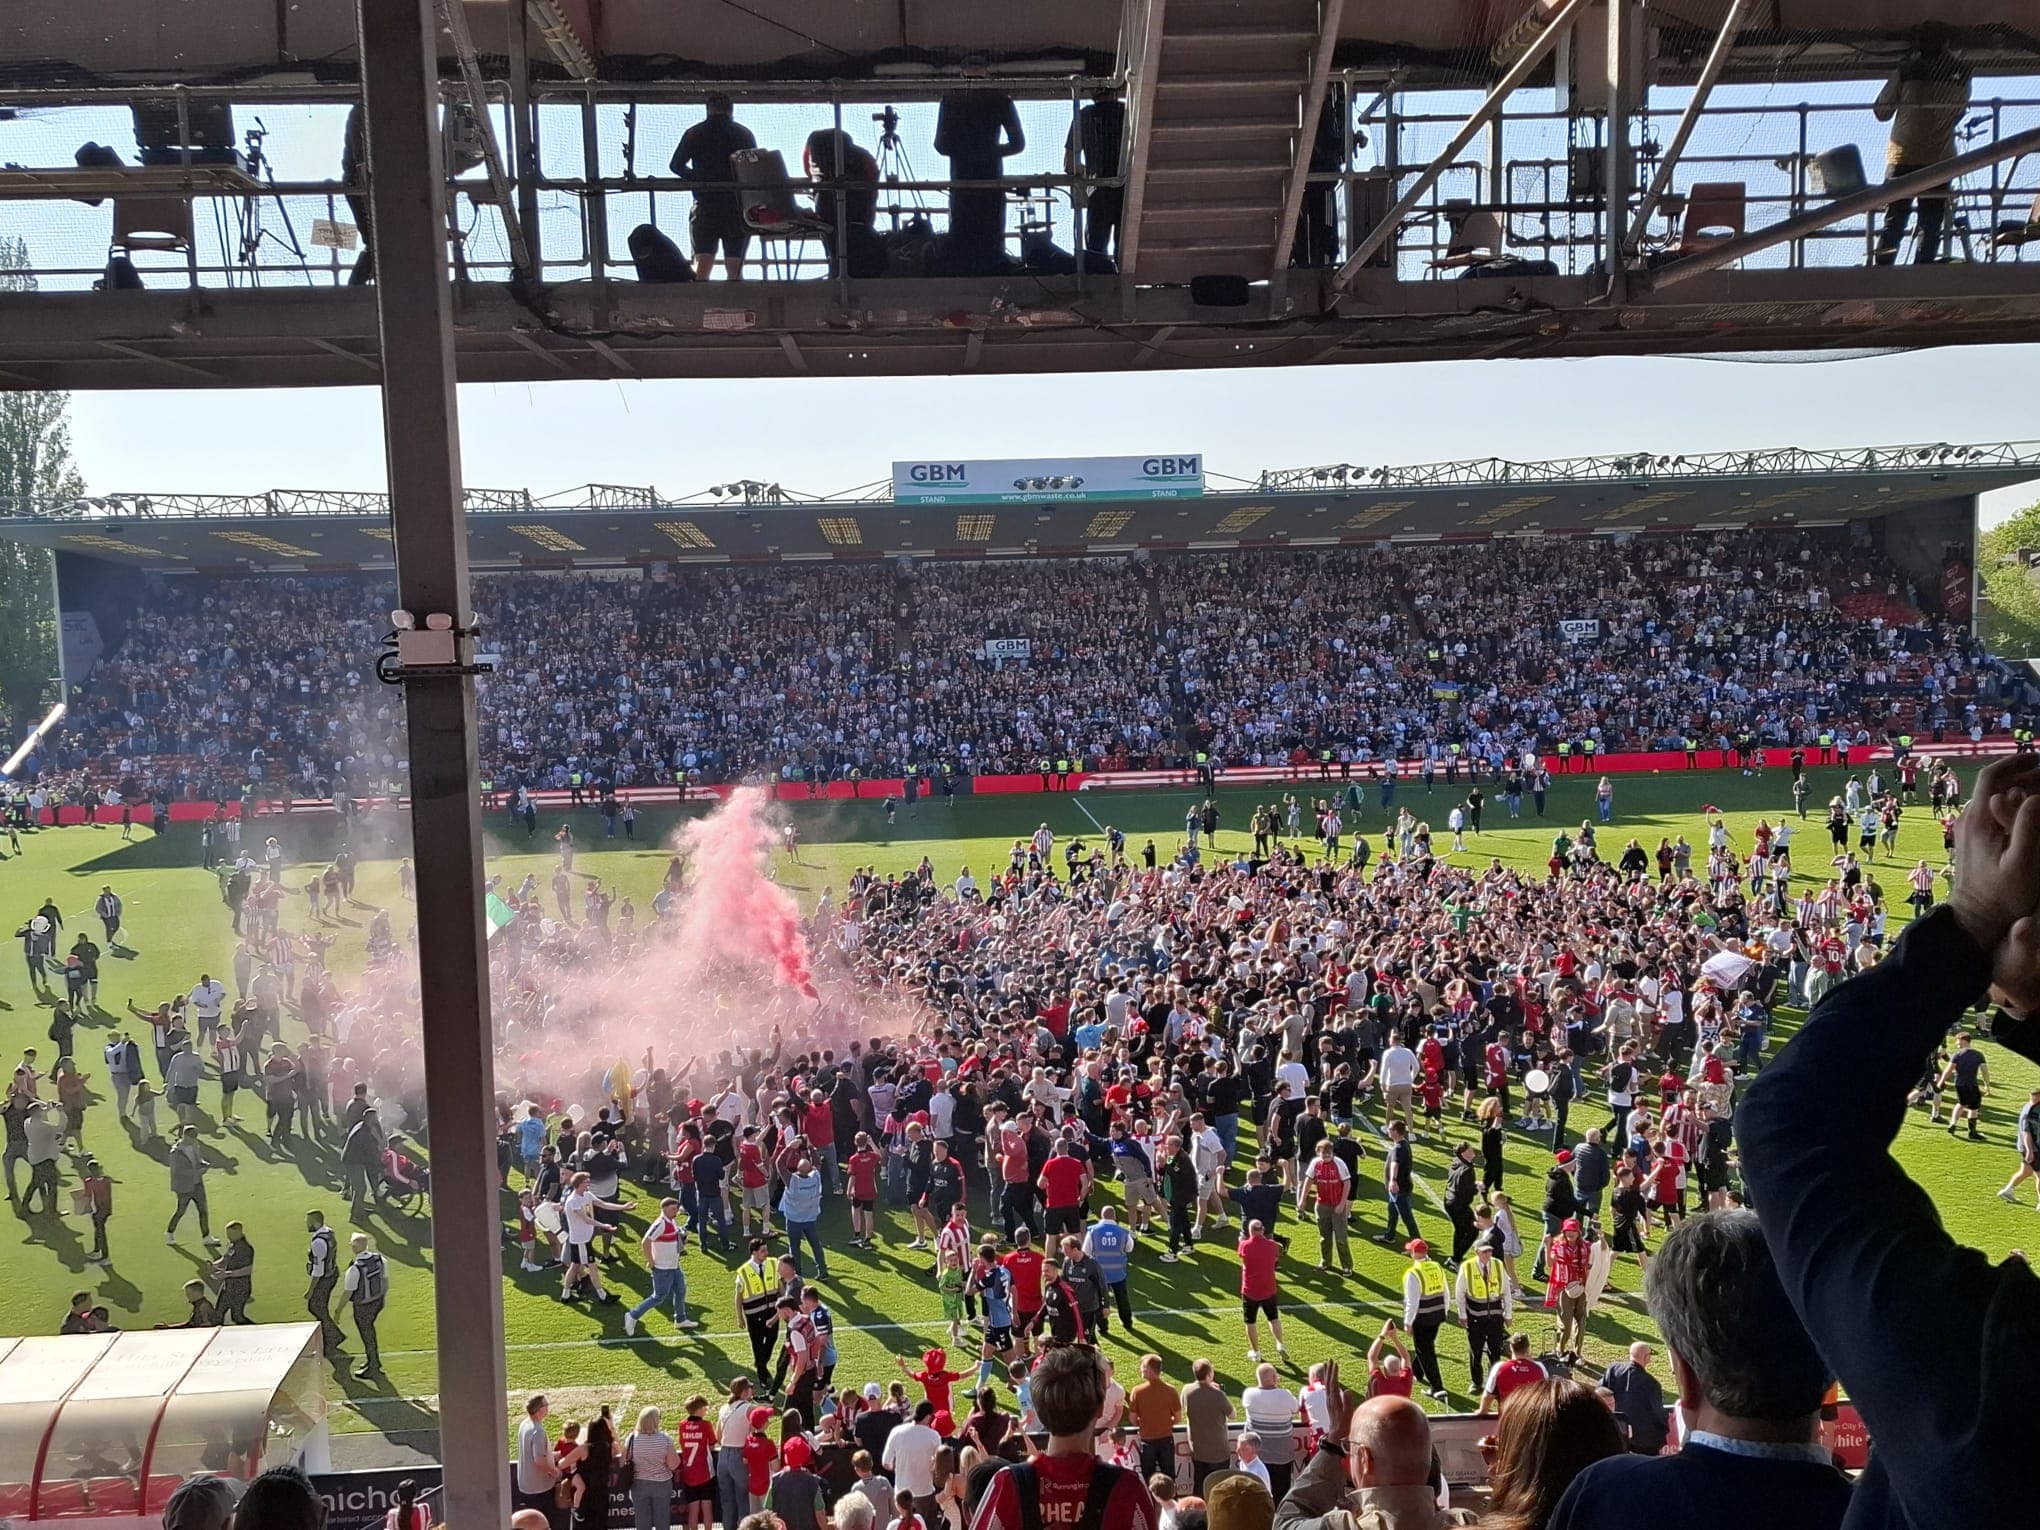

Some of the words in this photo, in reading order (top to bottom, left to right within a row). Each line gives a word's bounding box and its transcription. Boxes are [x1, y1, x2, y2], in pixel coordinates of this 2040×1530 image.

[1143, 458, 1197, 475] GBM
[910, 464, 965, 481] GBM
[1001, 492, 1087, 502] www.gbmwaste.co.uk
[1152, 490, 1177, 498] STAND
[920, 495, 946, 504] STAND
[1564, 622, 1596, 632] GBM
[995, 640, 1027, 650] GBM
[1826, 950, 1840, 962] 10
[1101, 1236, 1117, 1247] 019
[1842, 1422, 1857, 1431] City
[682, 1432, 703, 1440] TAYLOR
[684, 1442, 699, 1467] 7
